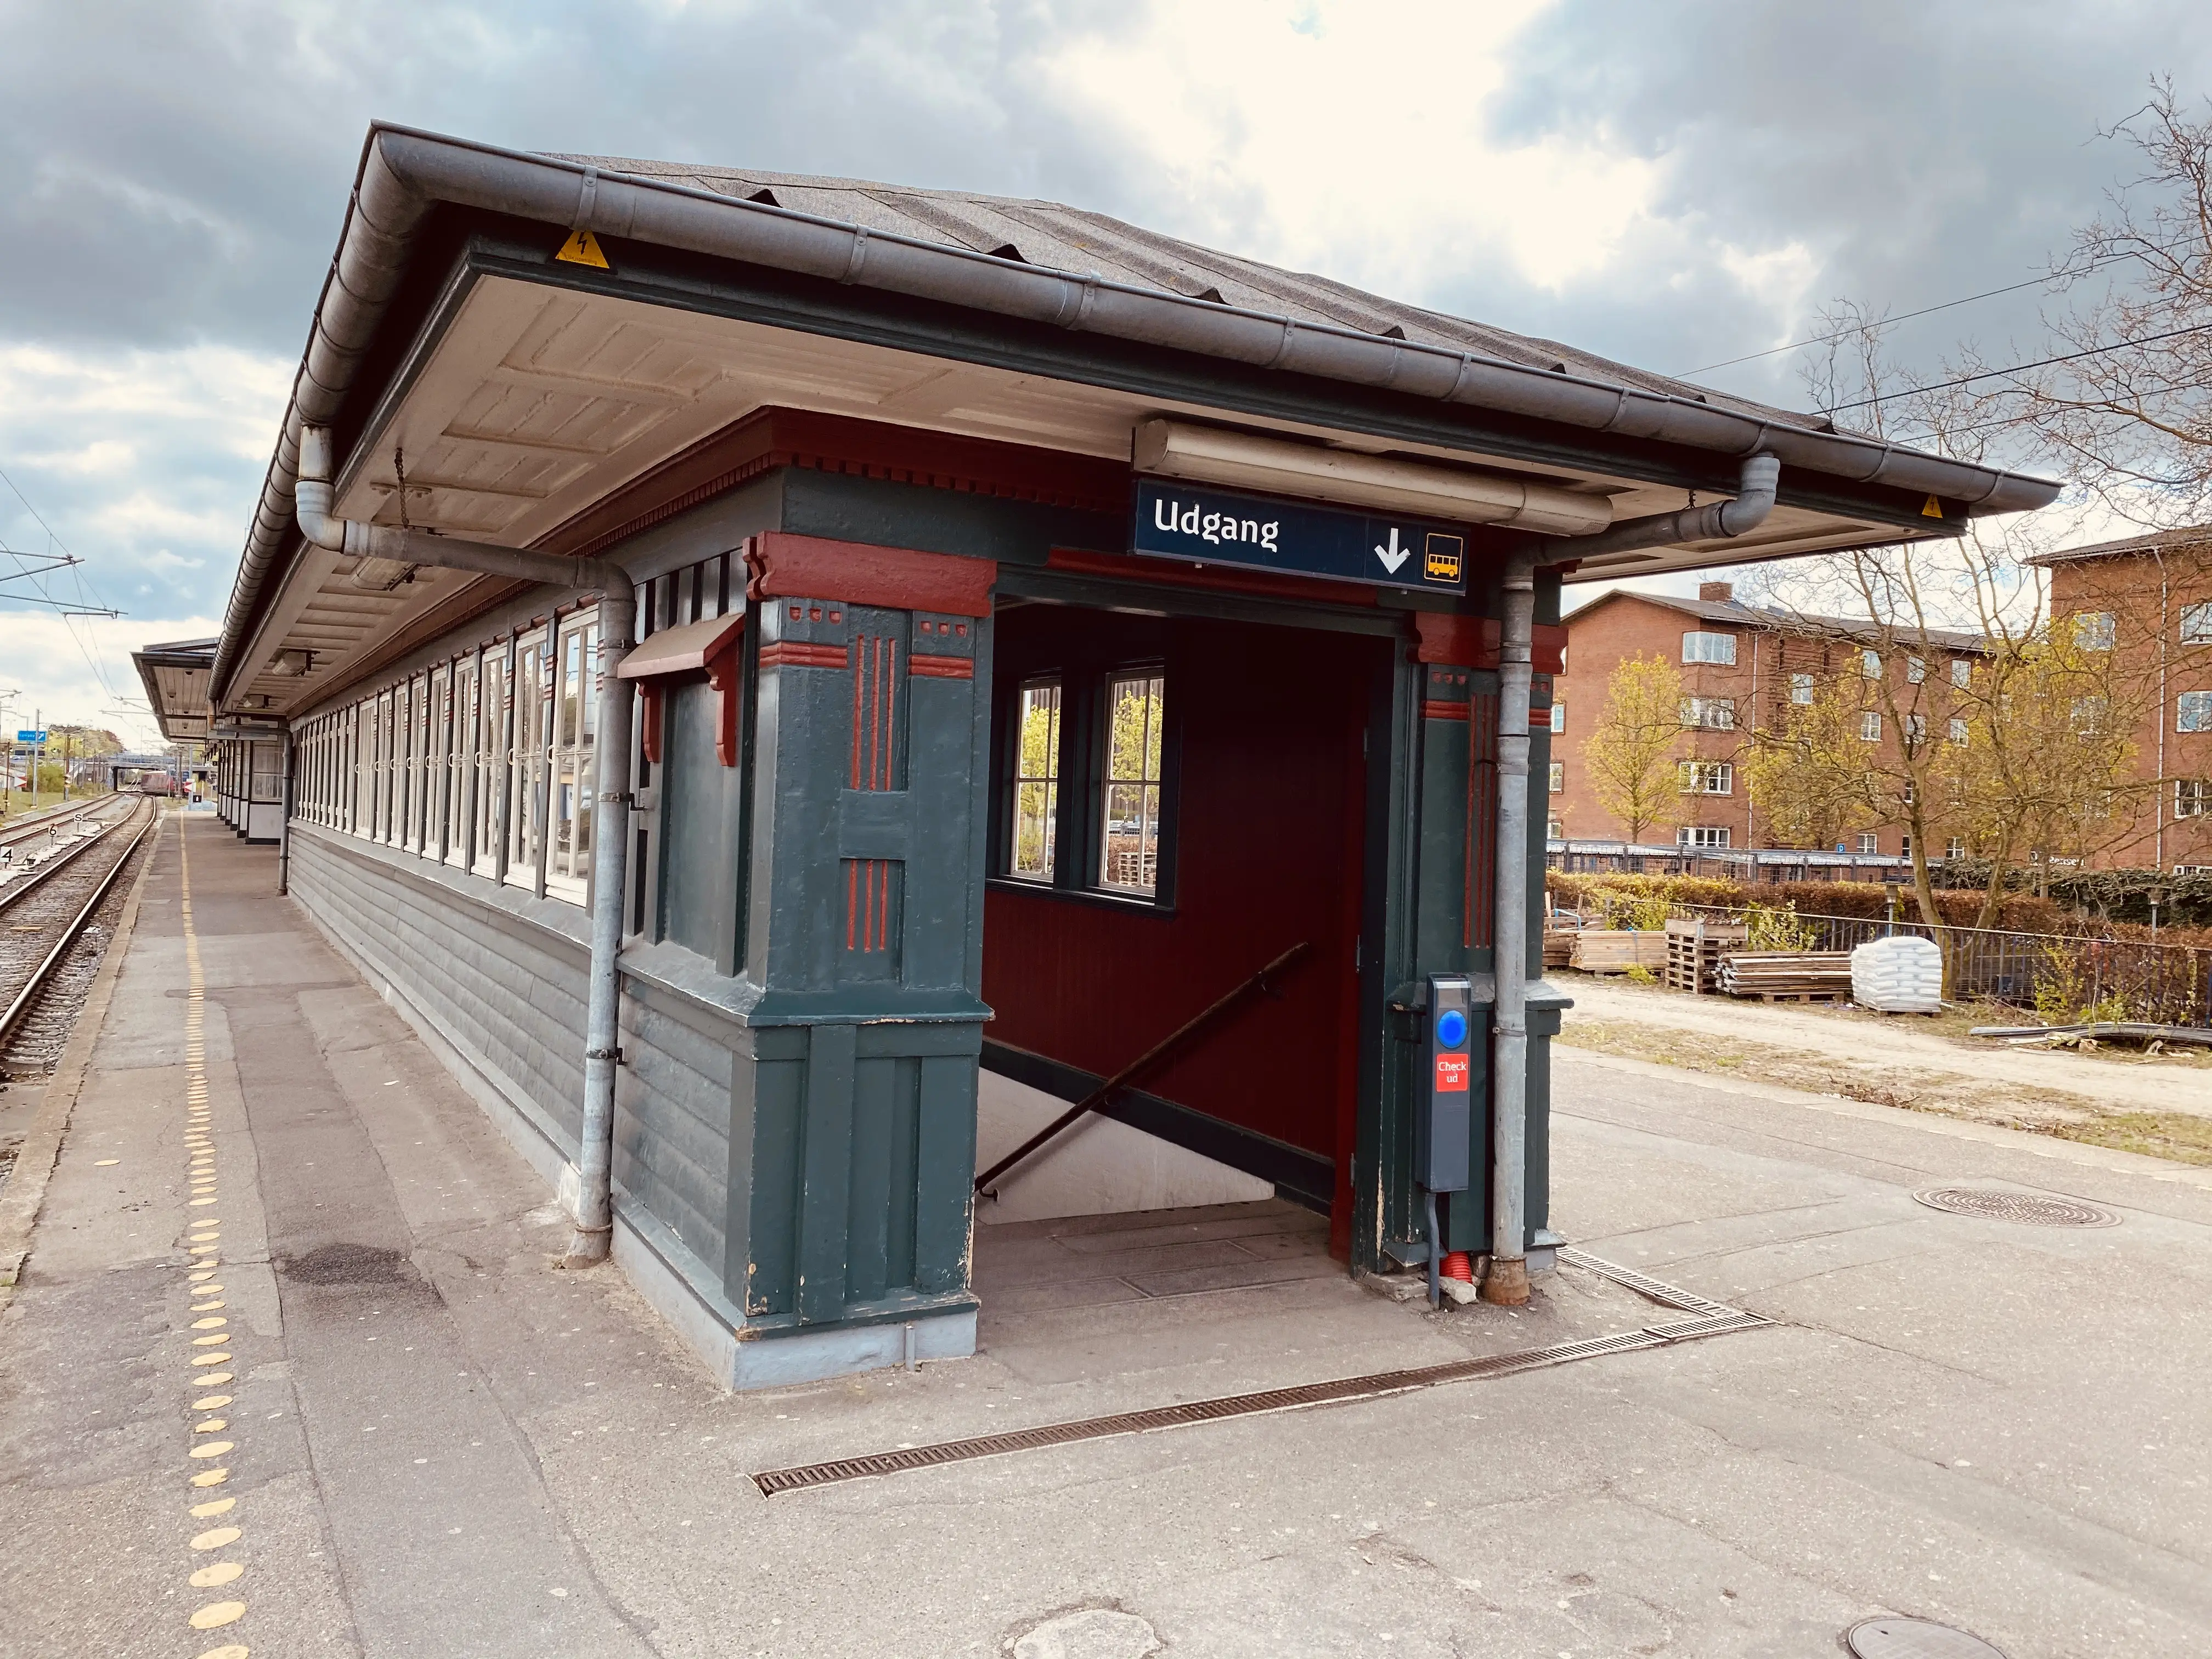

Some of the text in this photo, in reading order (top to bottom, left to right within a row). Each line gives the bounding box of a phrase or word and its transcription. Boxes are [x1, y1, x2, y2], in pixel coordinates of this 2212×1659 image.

[1154, 498, 1279, 553] Udgang
[75, 814, 82, 822] S
[49, 823, 57, 836] 6
[1, 848, 13, 862] 4
[1438, 1061, 1467, 1072] Check
[1446, 1073, 1458, 1084] ud
